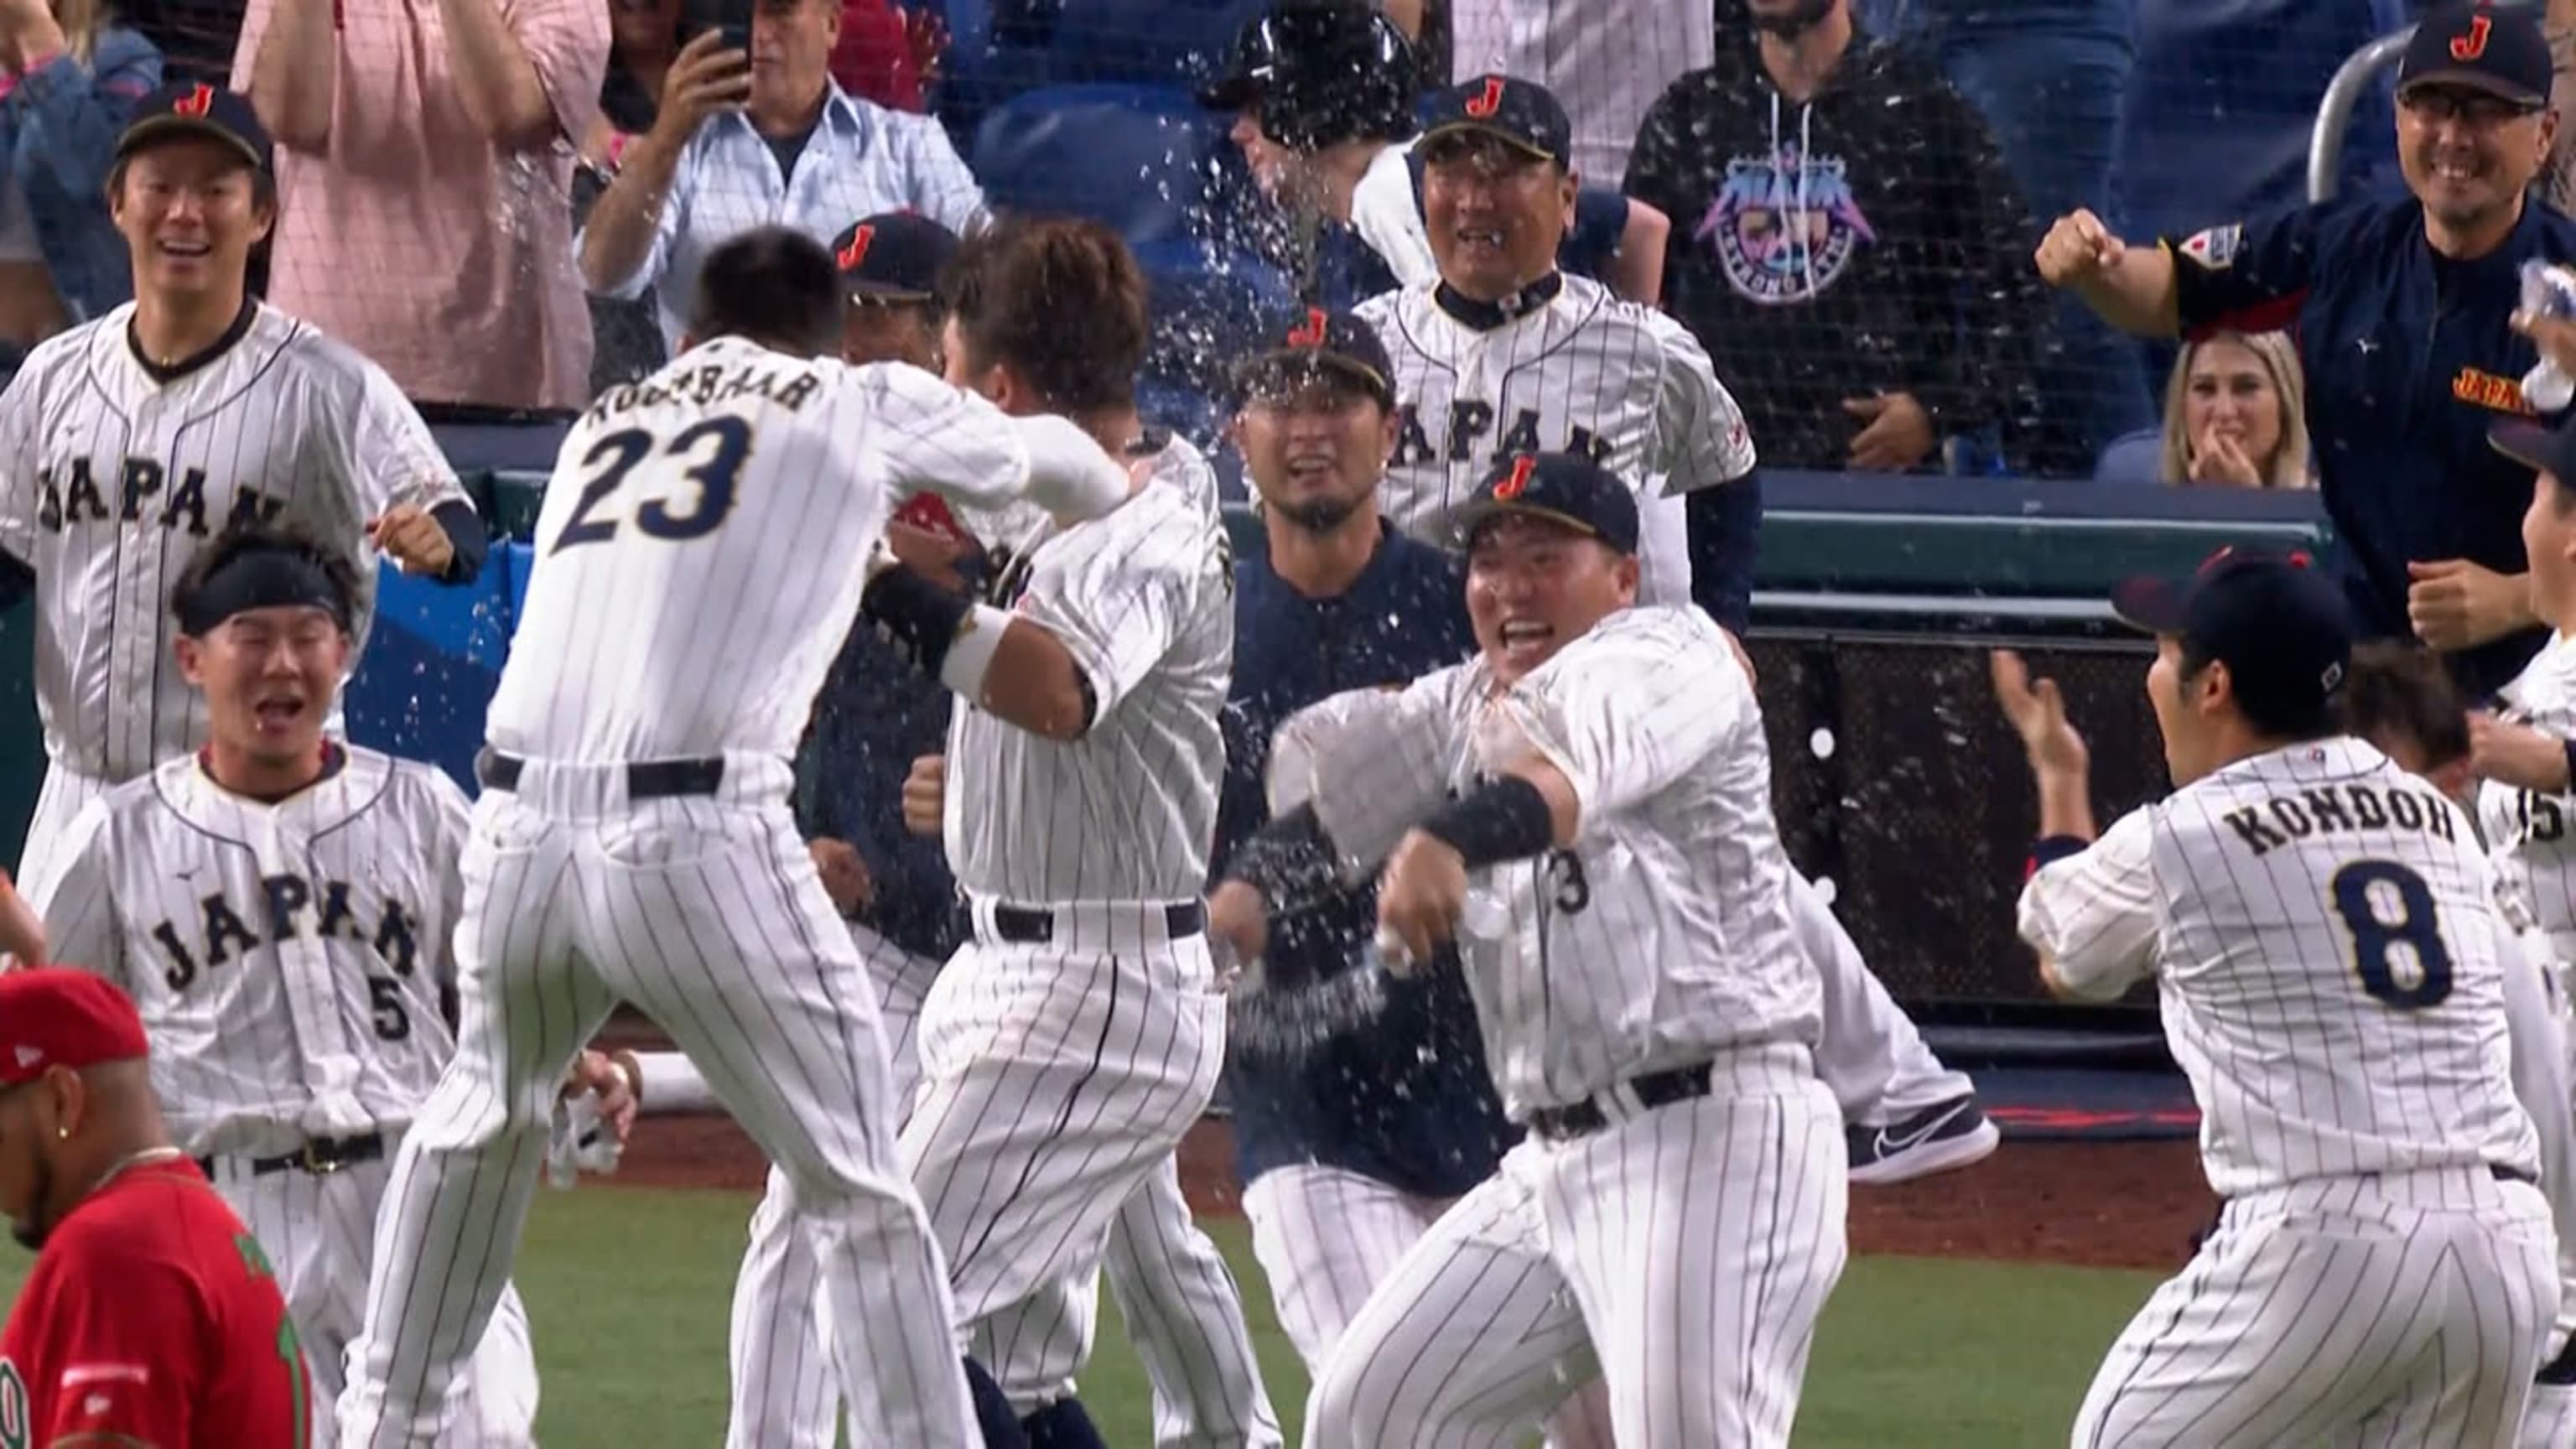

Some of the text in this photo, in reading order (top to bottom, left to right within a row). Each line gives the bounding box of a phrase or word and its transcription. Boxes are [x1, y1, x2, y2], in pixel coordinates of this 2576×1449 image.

[2450, 15, 2492, 60] J
[174, 81, 214, 118] J
[1466, 75, 1504, 117] J
[837, 224, 875, 271] J
[1288, 307, 1327, 349] J
[2452, 366, 2527, 414] JAPA
[548, 415, 754, 558] 23
[1493, 454, 1536, 501] J
[2224, 786, 2456, 856] KONDOH
[154, 874, 418, 992] JAPAN
[2327, 857, 2454, 1010] 8
[369, 976, 409, 1041] 5
